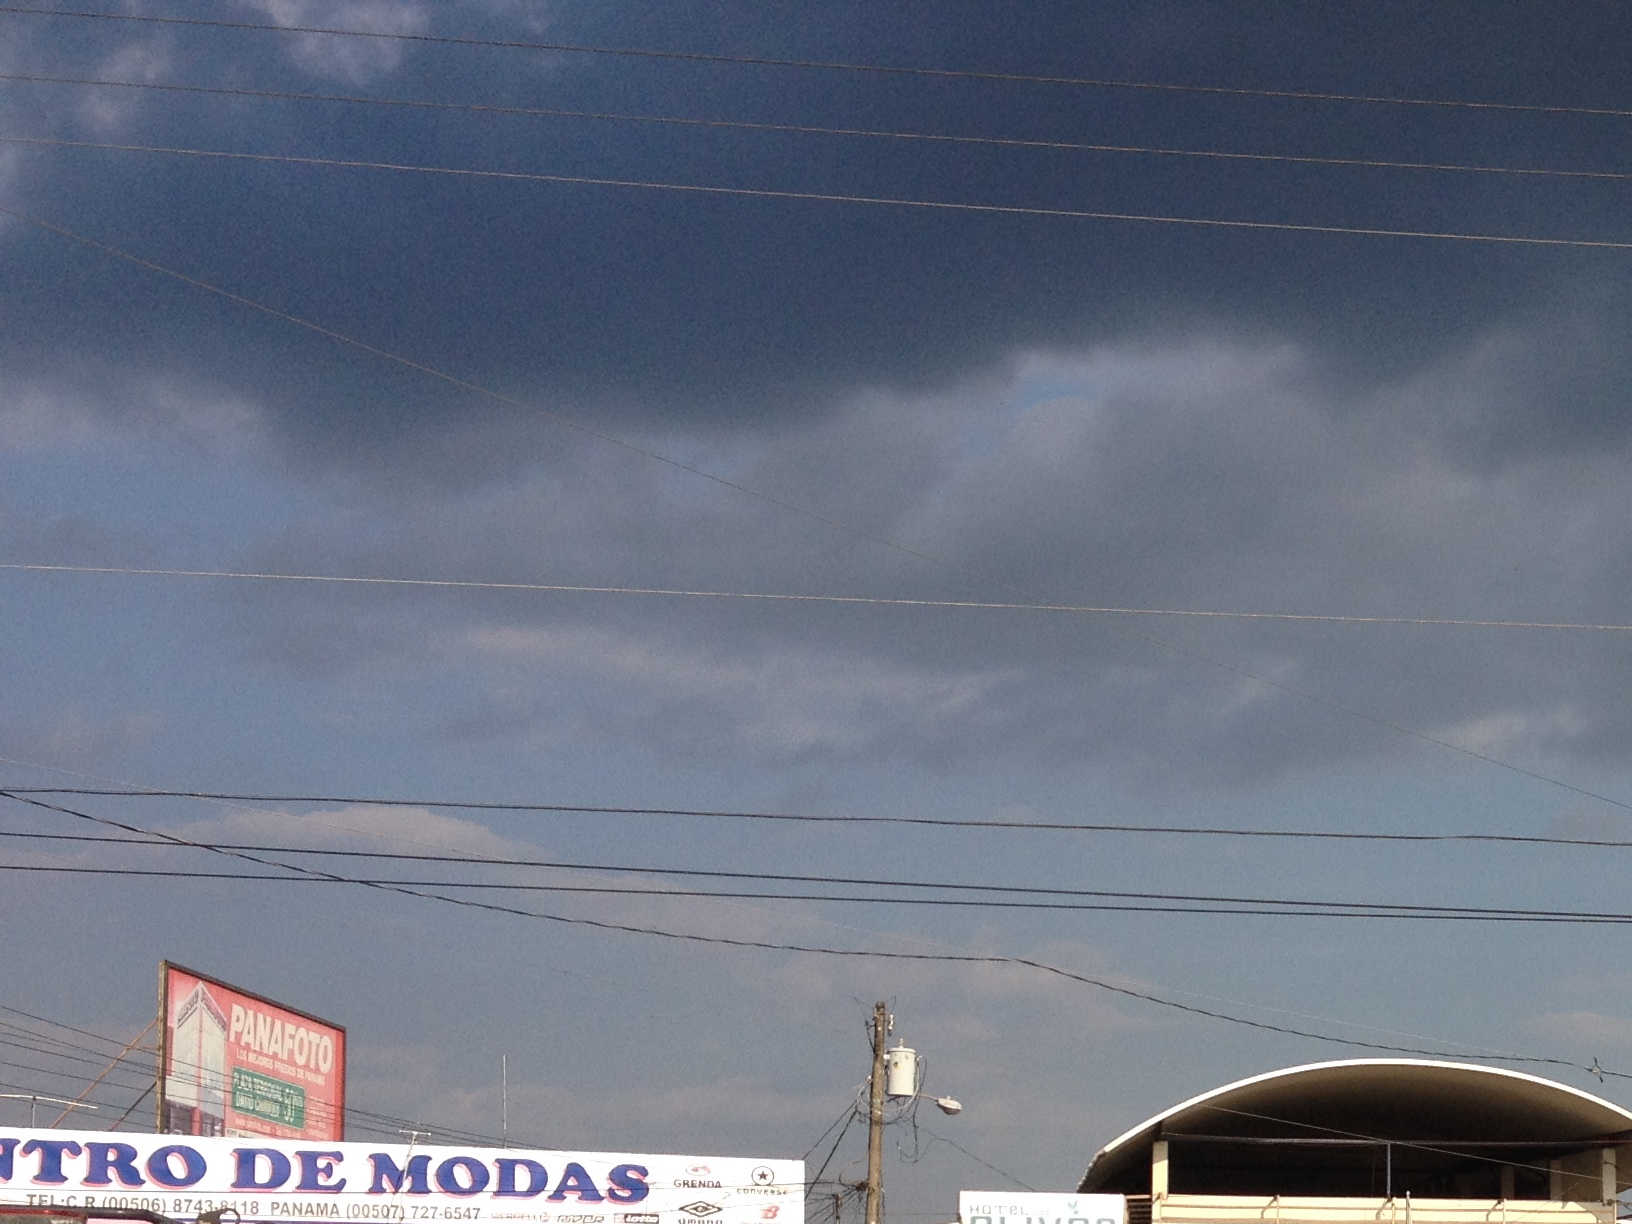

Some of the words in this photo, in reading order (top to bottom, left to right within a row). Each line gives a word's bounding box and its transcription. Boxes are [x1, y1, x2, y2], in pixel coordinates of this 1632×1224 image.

[229, 1003, 333, 1074] PANAFOTO
[230, 1148, 347, 1194] DE
[366, 1153, 650, 1205] MODAS
[673, 1179, 722, 1189] GRENDA
[103, 1196, 167, 1214] (00506)
[346, 1203, 405, 1220] (00507)
[411, 1206, 481, 1220] 727-6547
